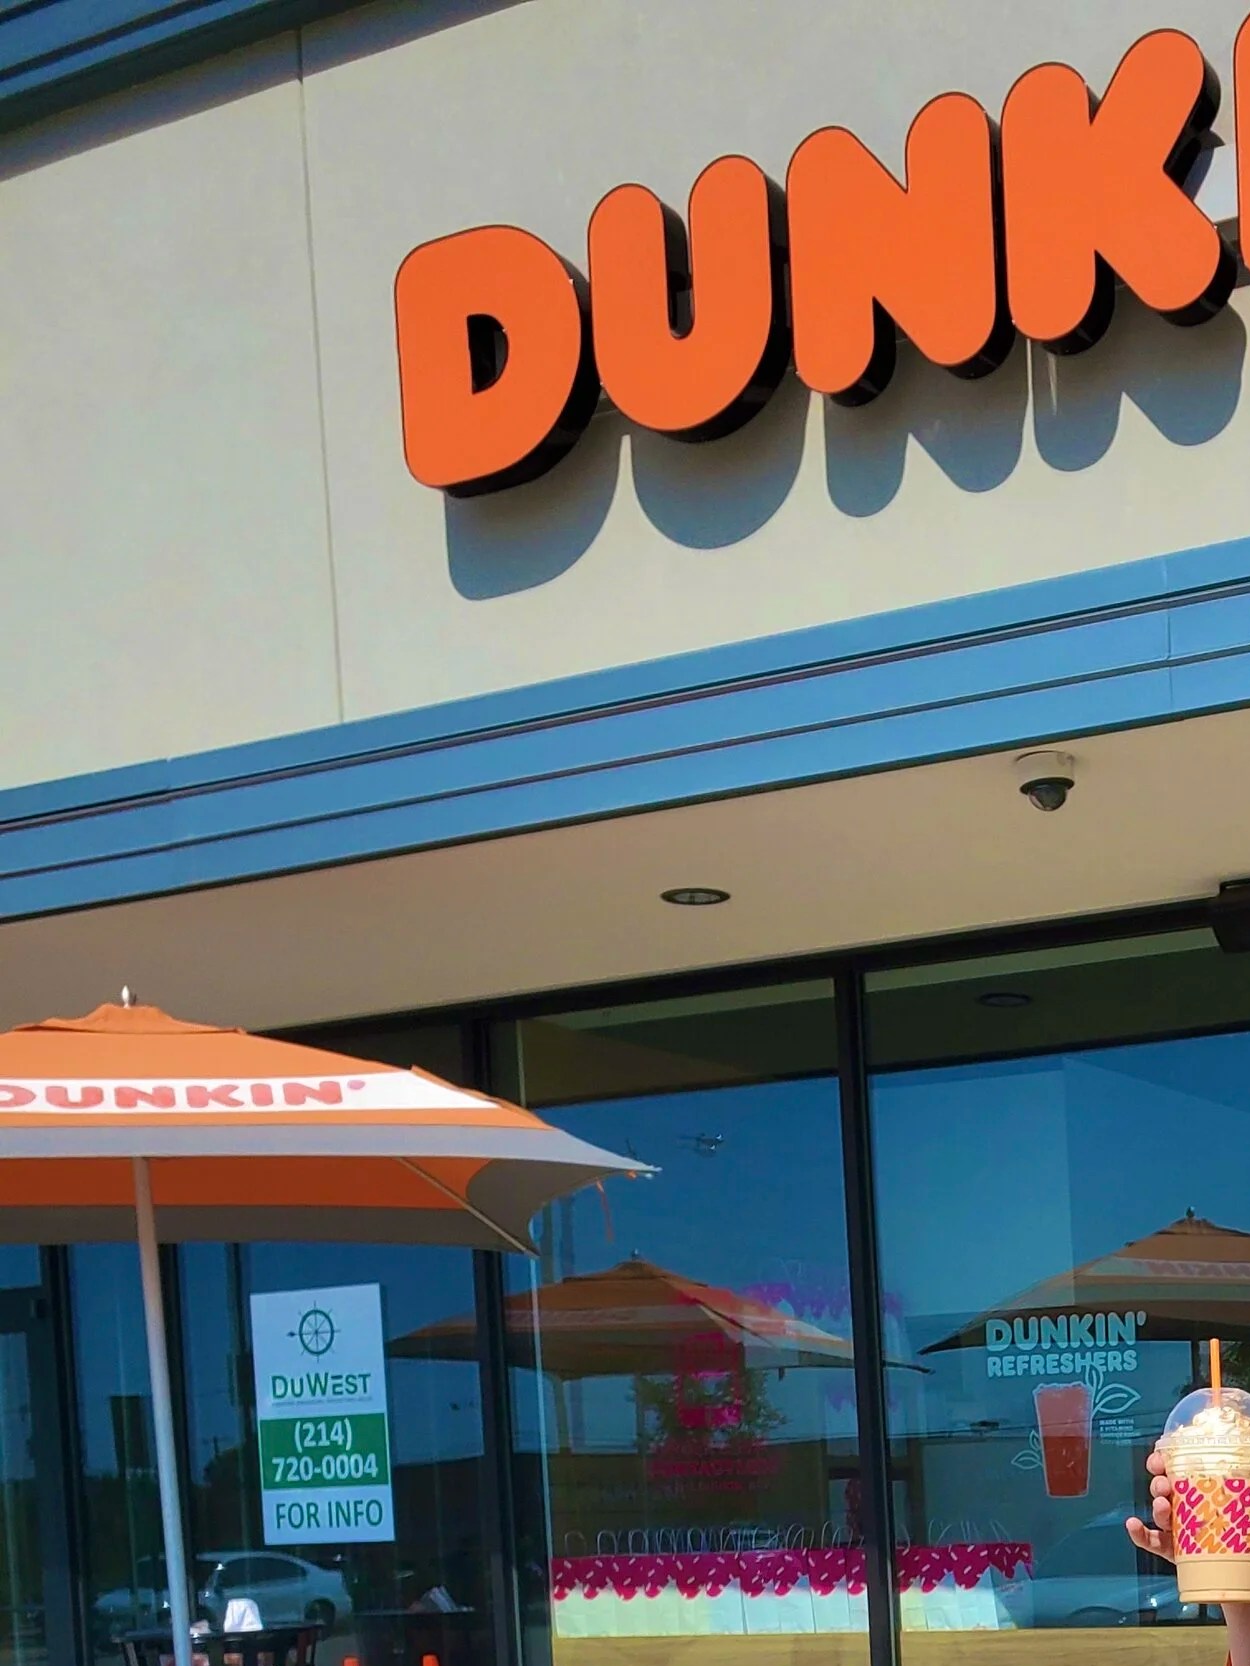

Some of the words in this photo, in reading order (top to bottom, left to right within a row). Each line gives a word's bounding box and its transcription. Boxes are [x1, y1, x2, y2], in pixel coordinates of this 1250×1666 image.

[986, 1311, 1147, 1351] DUNKIN'
[987, 1350, 1138, 1378] REFRESHERS
[294, 1418, 353, 1453] (214)
[272, 1454, 379, 1482] 720-0004
[276, 1502, 321, 1529] FOR
[328, 1499, 384, 1528] INFO
